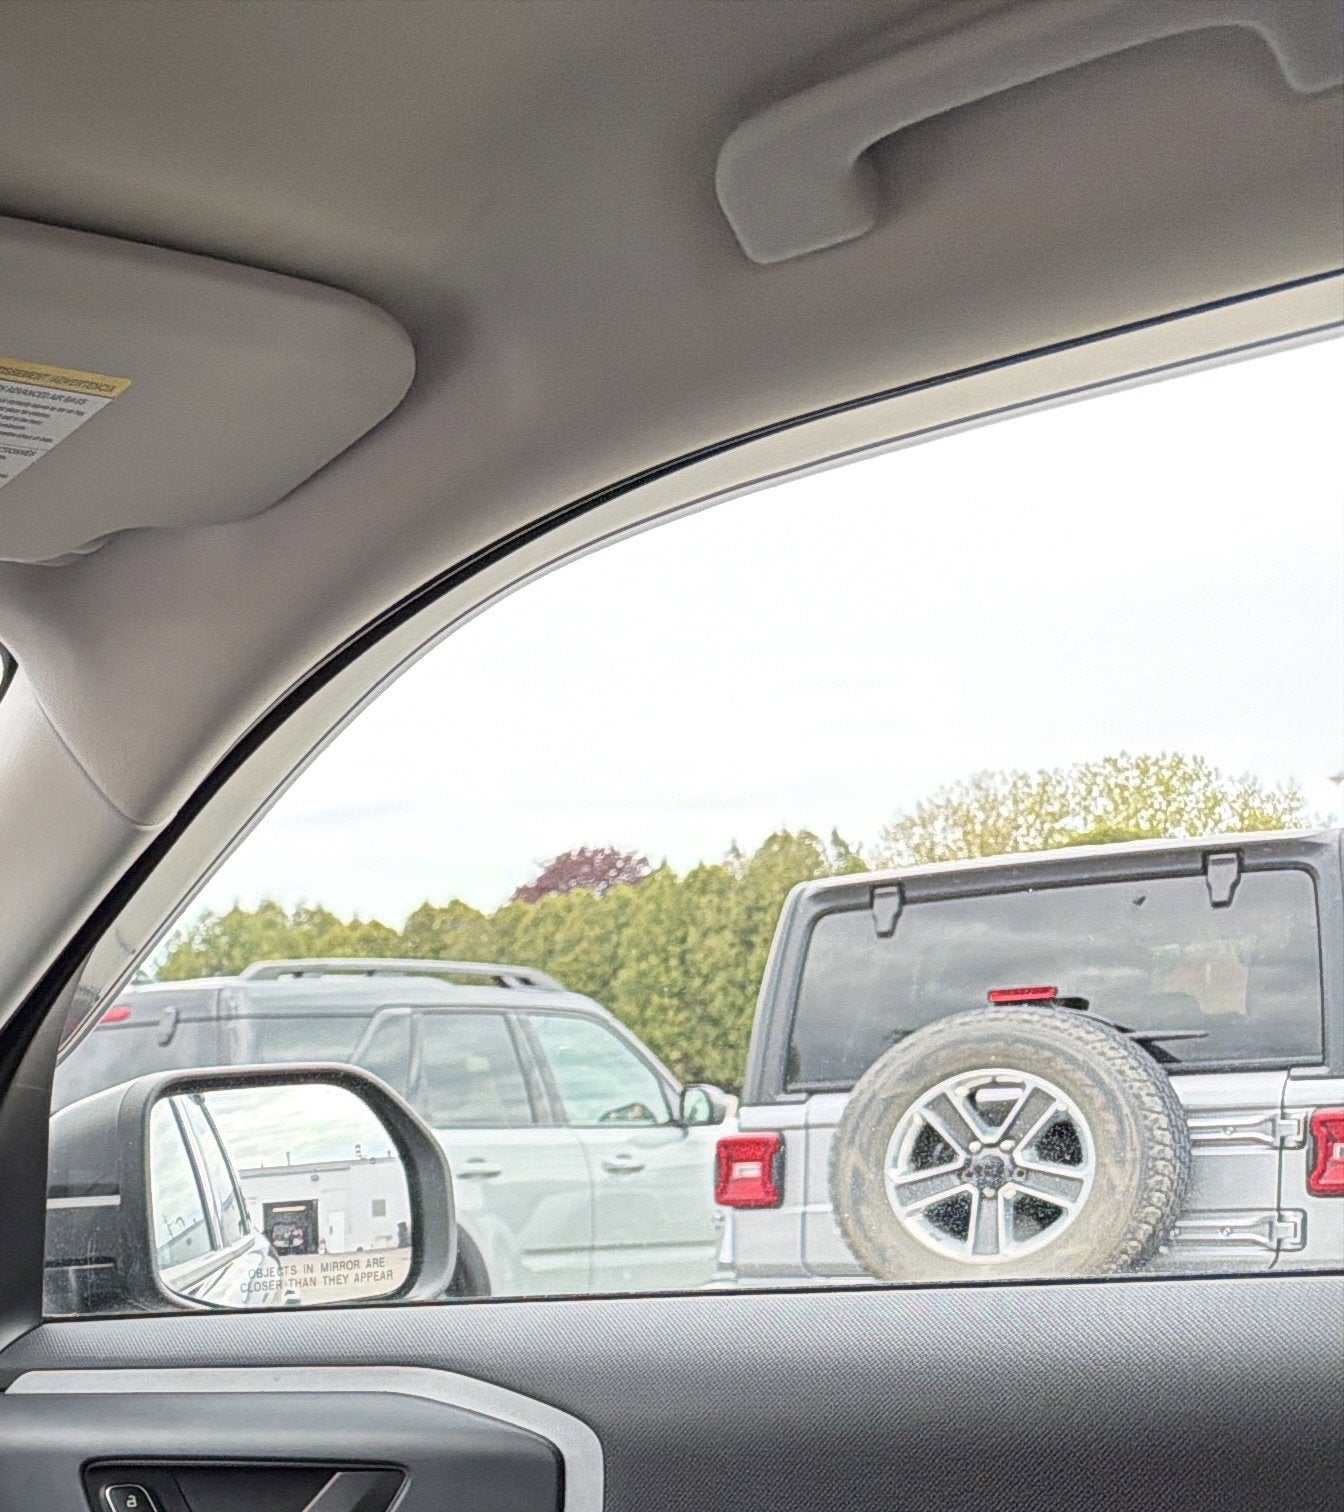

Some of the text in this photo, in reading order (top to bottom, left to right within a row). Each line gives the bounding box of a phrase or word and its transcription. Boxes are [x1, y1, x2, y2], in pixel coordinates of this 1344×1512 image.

[248, 1257, 386, 1279] OBJECTS IN MIRROR ARE
[240, 1269, 393, 1293] CLOSER THAN THEY APPEAR
